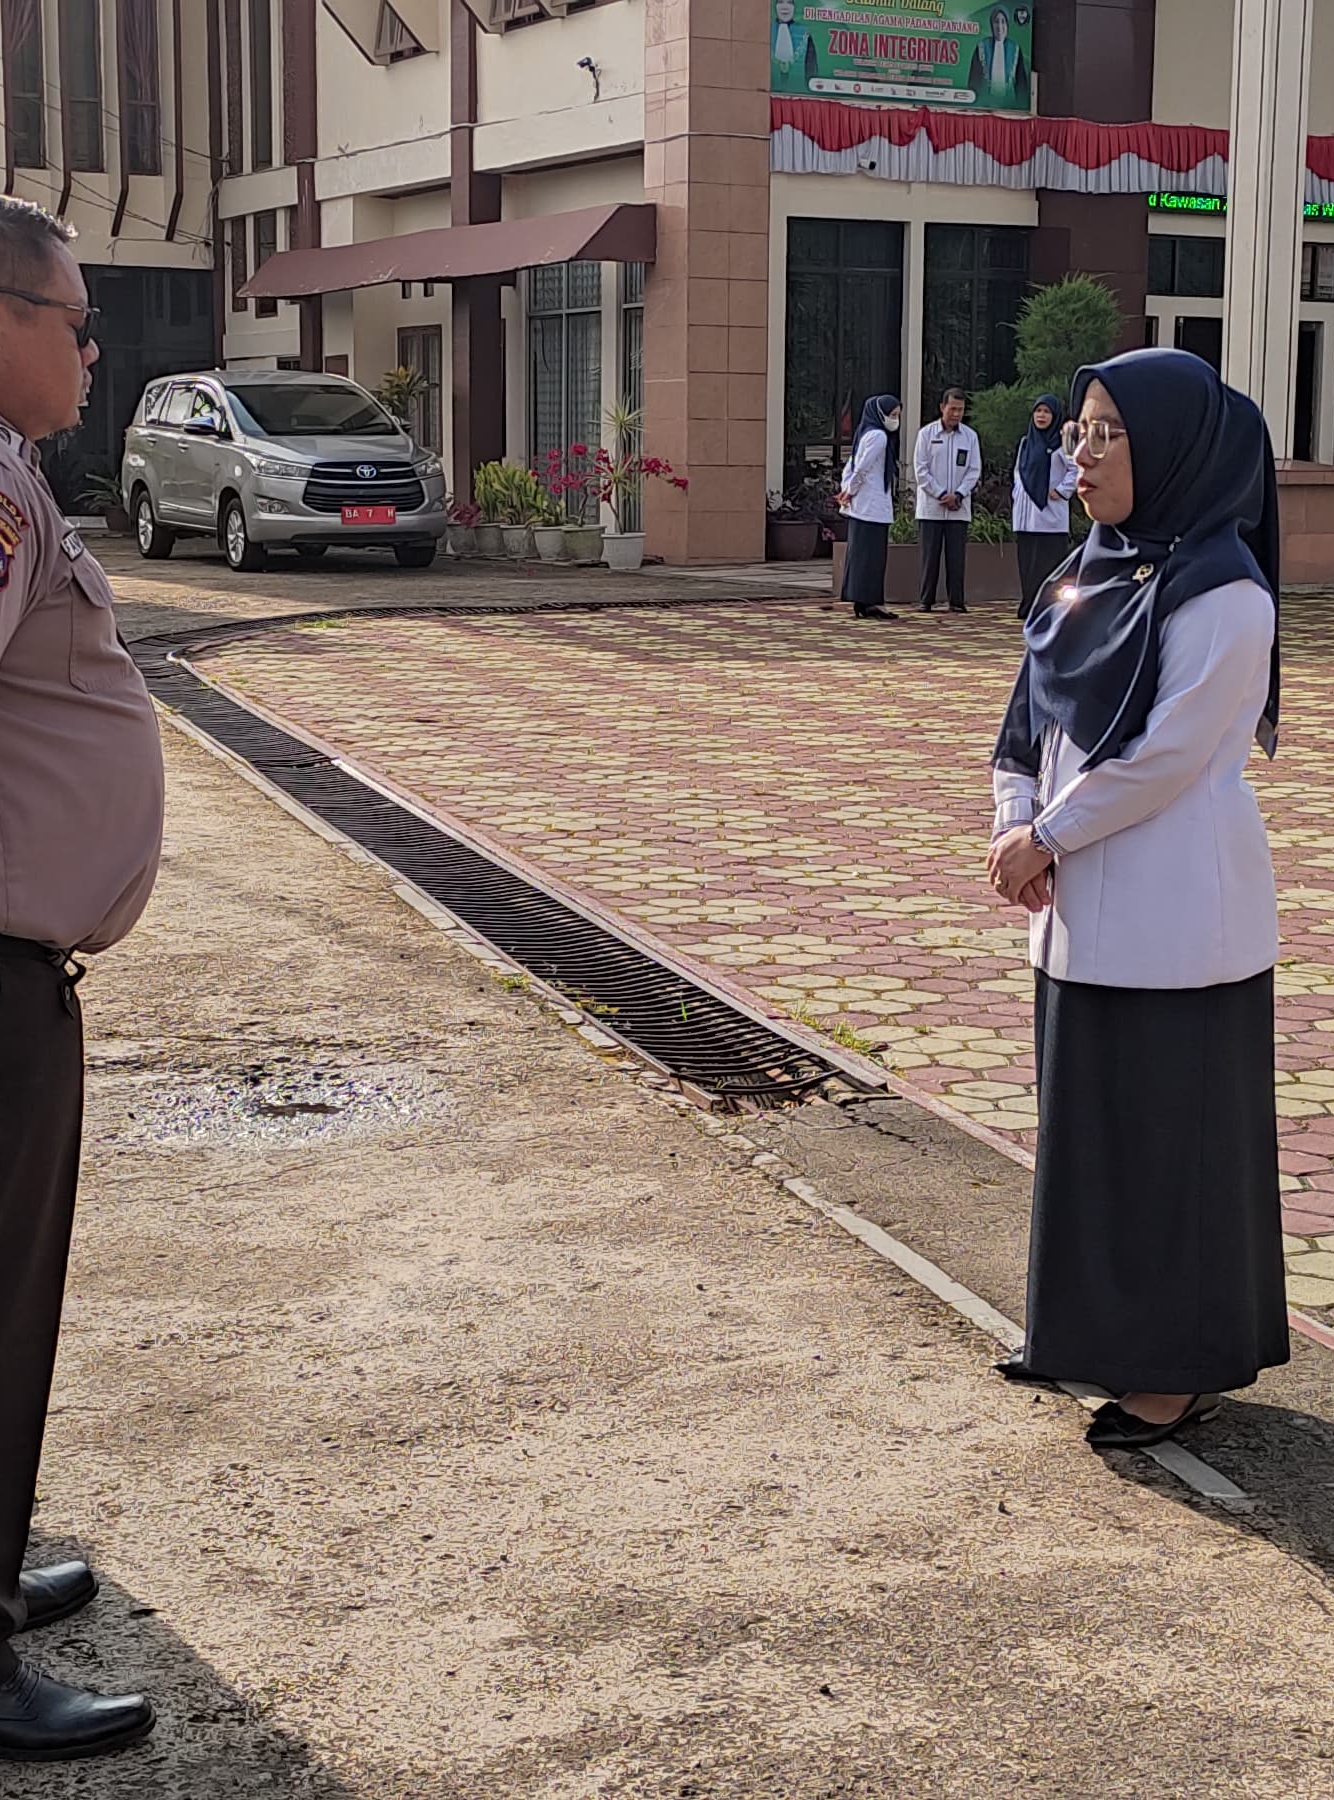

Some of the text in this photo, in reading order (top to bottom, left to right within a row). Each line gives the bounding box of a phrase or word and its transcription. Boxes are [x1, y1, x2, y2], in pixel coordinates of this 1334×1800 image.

[828, 29, 869, 56] ZONA
[874, 33, 959, 65] INTEGRITAS
[1160, 193, 1220, 211] Kawasan
[345, 508, 359, 519] BA
[366, 508, 373, 519] 7
